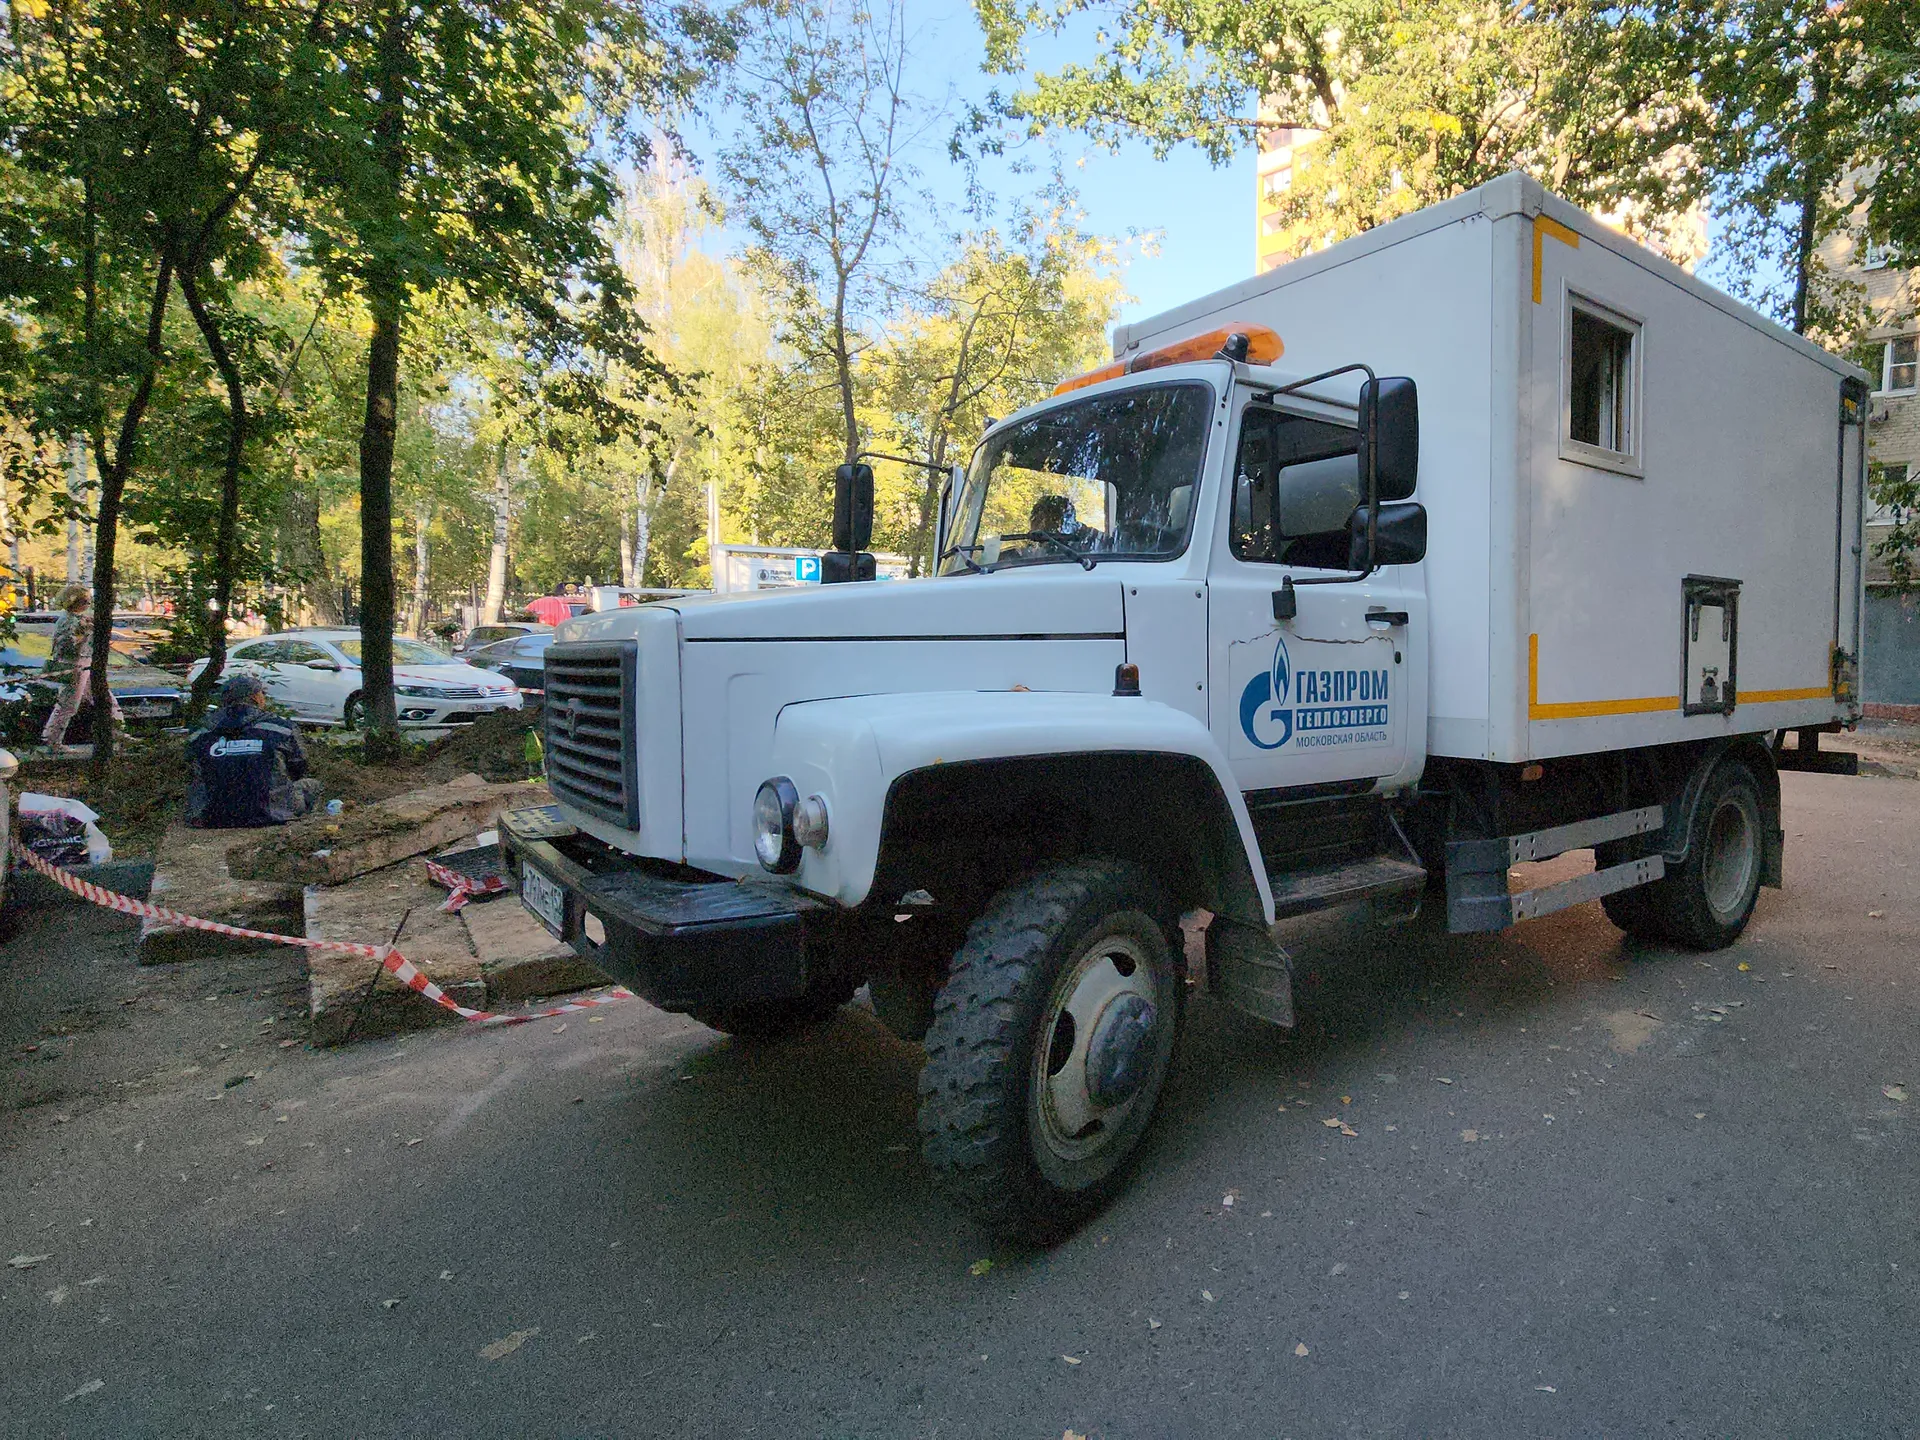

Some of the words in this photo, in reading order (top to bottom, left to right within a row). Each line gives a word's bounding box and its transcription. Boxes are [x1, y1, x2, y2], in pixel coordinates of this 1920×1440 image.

[801, 559, 816, 579] P
[1296, 670, 1389, 703] ГАЗПРОМ
[1297, 708, 1387, 729] ТЕПЛОЭНЕРГО
[1296, 733, 1353, 748] МОСКОВСКАЯ
[1354, 731, 1387, 743] ОБЛАСТЬ
